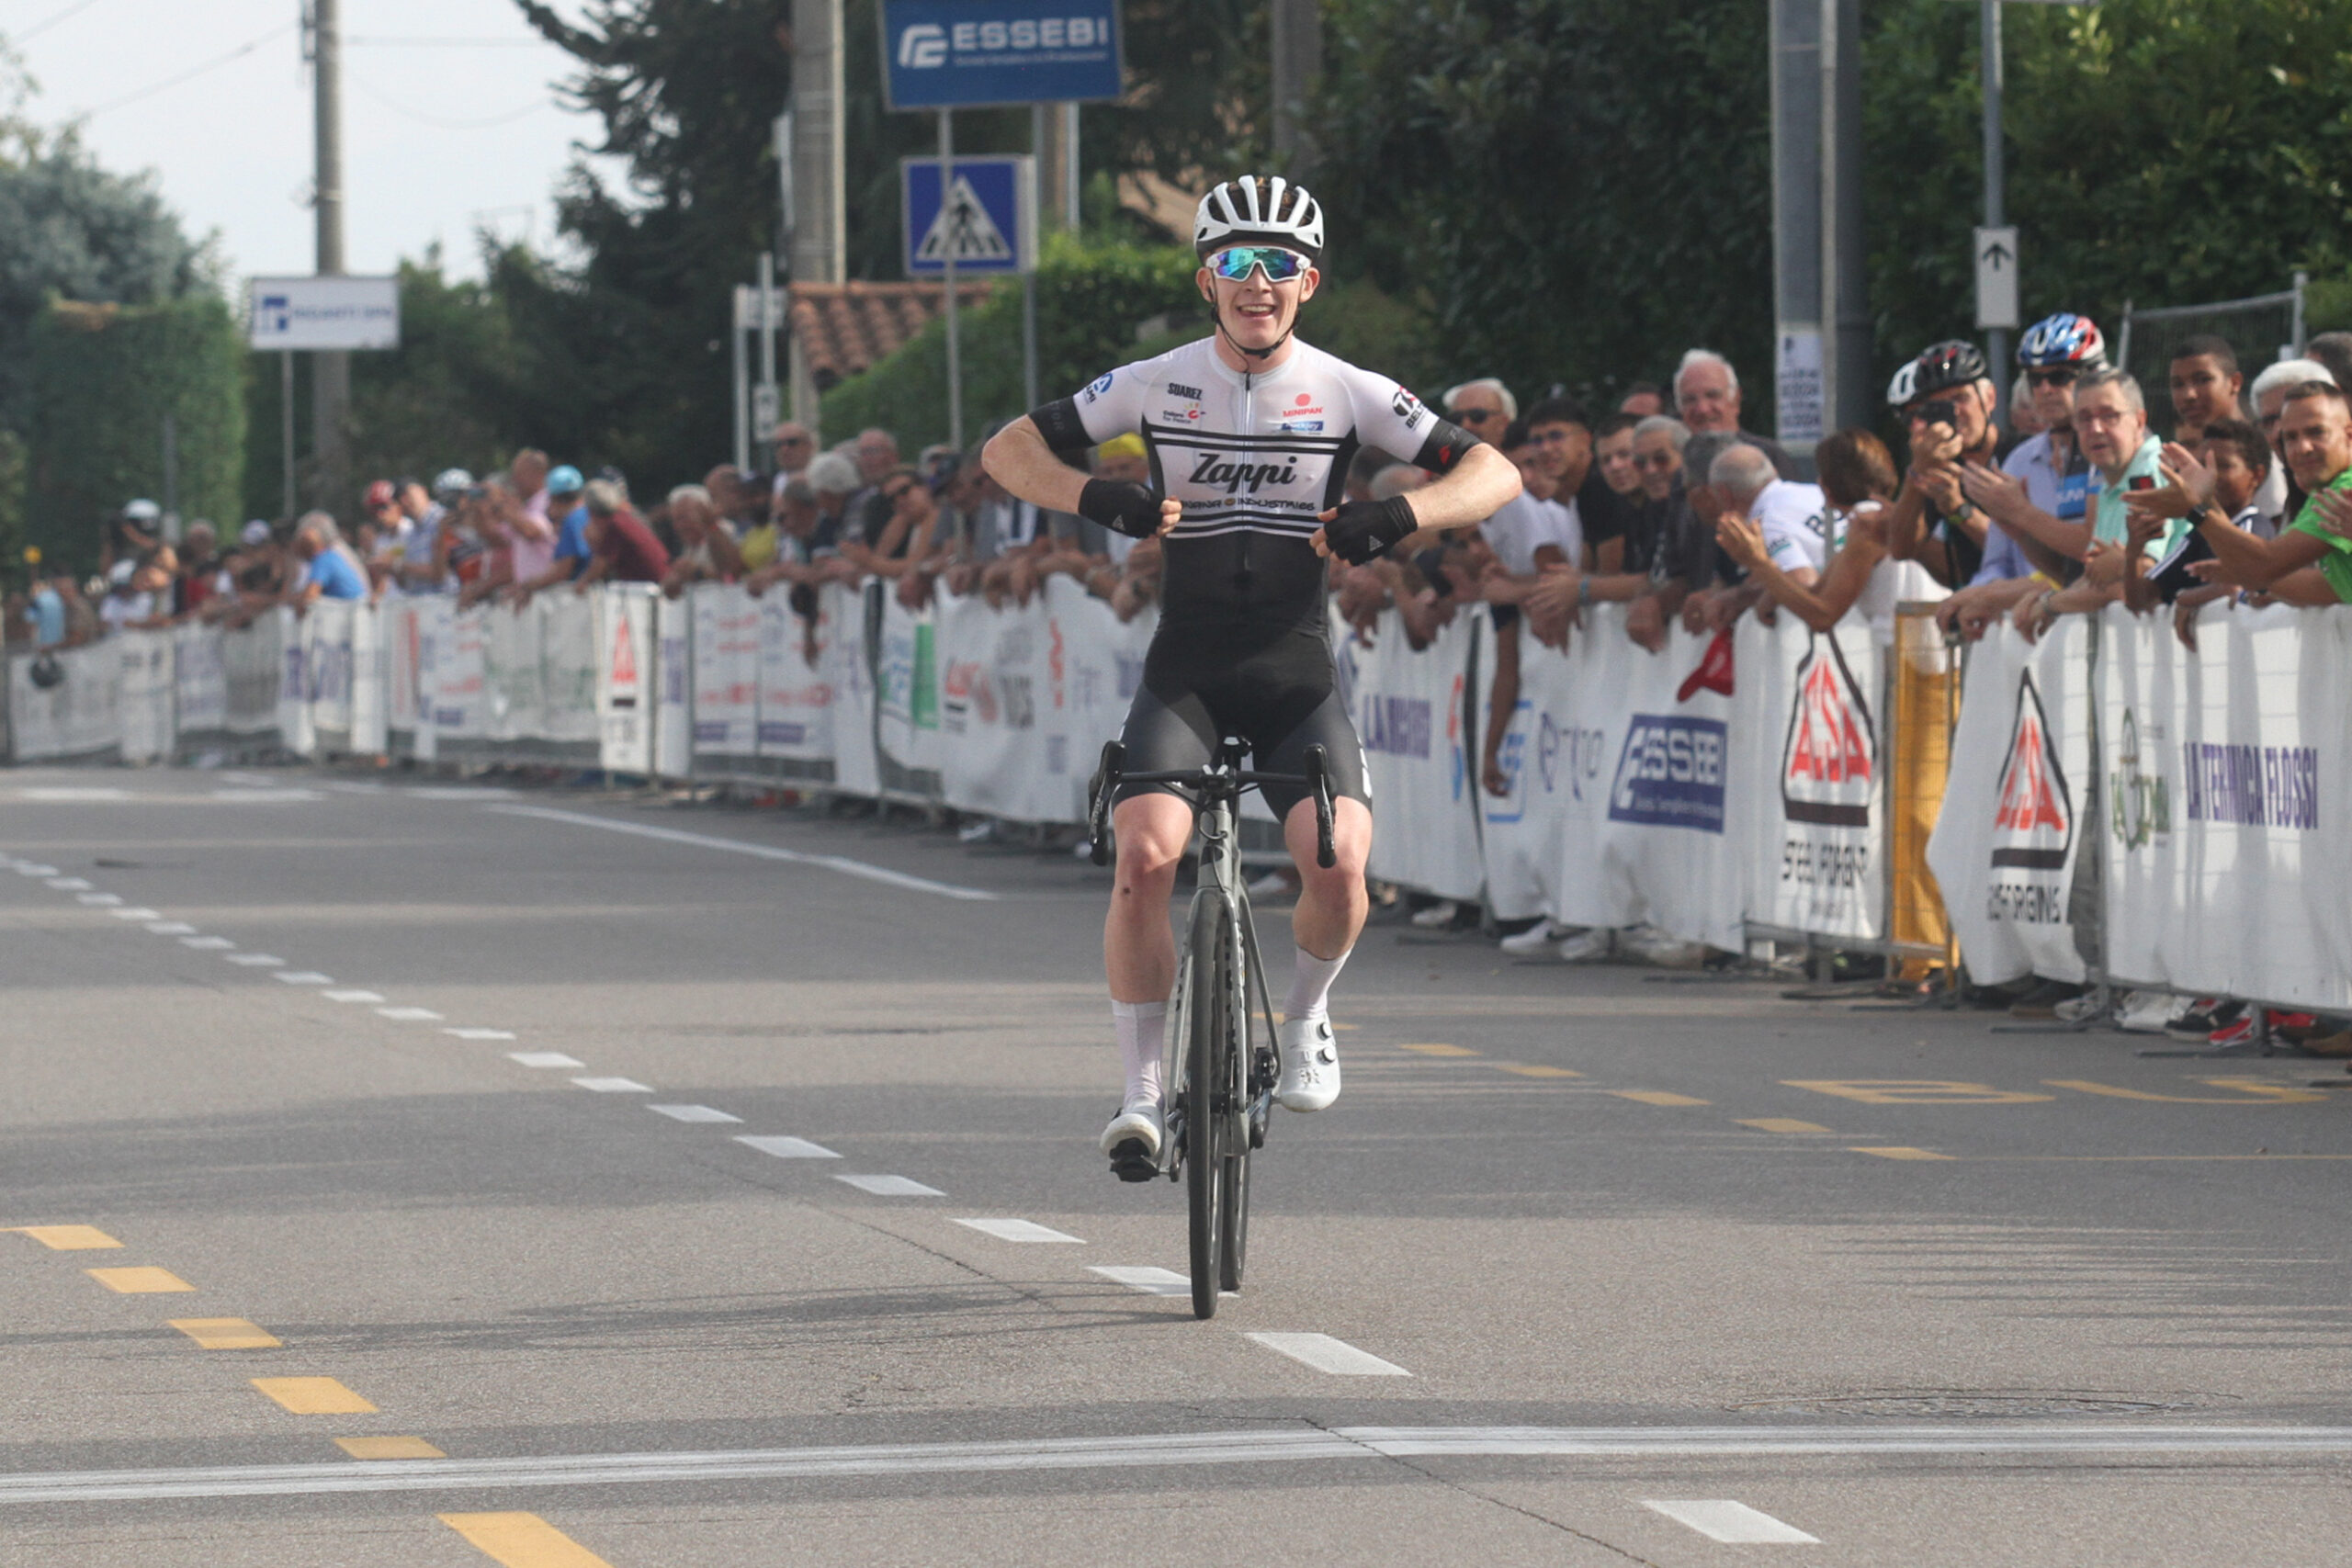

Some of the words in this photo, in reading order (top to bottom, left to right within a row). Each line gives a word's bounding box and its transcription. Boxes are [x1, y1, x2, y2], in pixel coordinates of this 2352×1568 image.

[952, 17, 1108, 51] ESSEBI
[1168, 382, 1203, 400] SUAREZ
[1283, 407, 1323, 417] MINIPAN
[1188, 453, 1296, 494] Zappi
